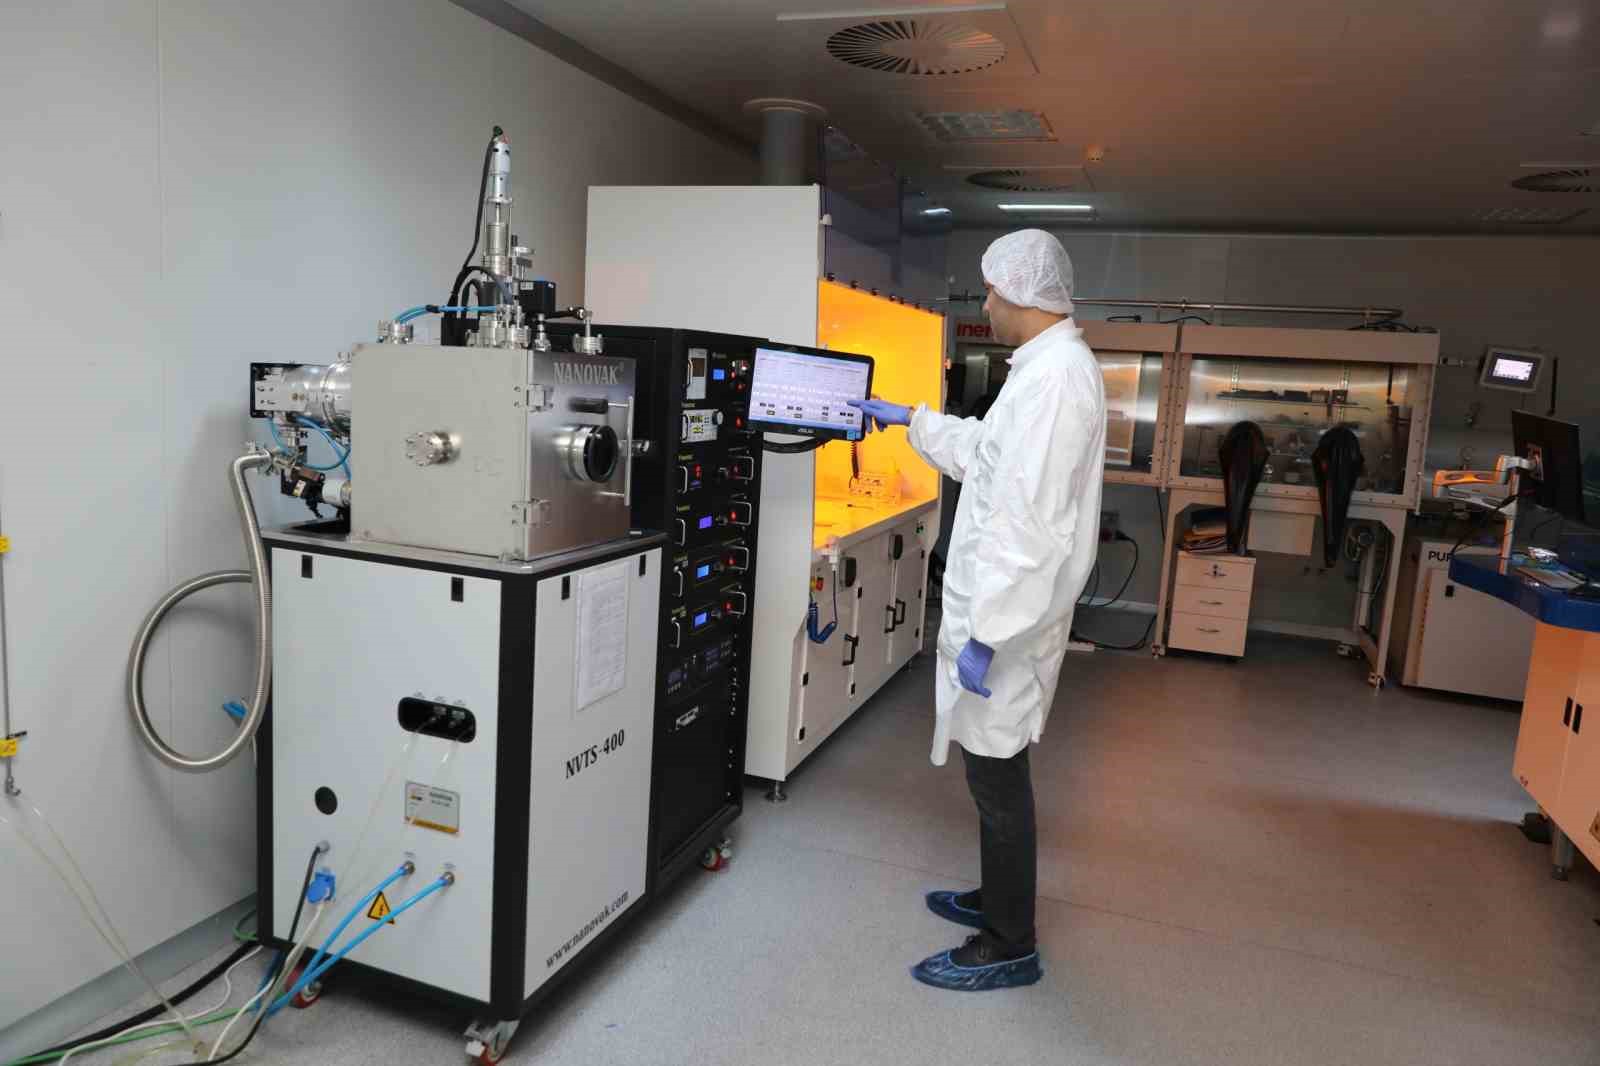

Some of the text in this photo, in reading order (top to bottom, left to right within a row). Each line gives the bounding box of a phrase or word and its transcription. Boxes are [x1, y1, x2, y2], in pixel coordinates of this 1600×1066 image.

[553, 361, 618, 385] NANOVAK
[565, 729, 625, 780] NVTS-400
[546, 891, 629, 968] www.nanovak.com
